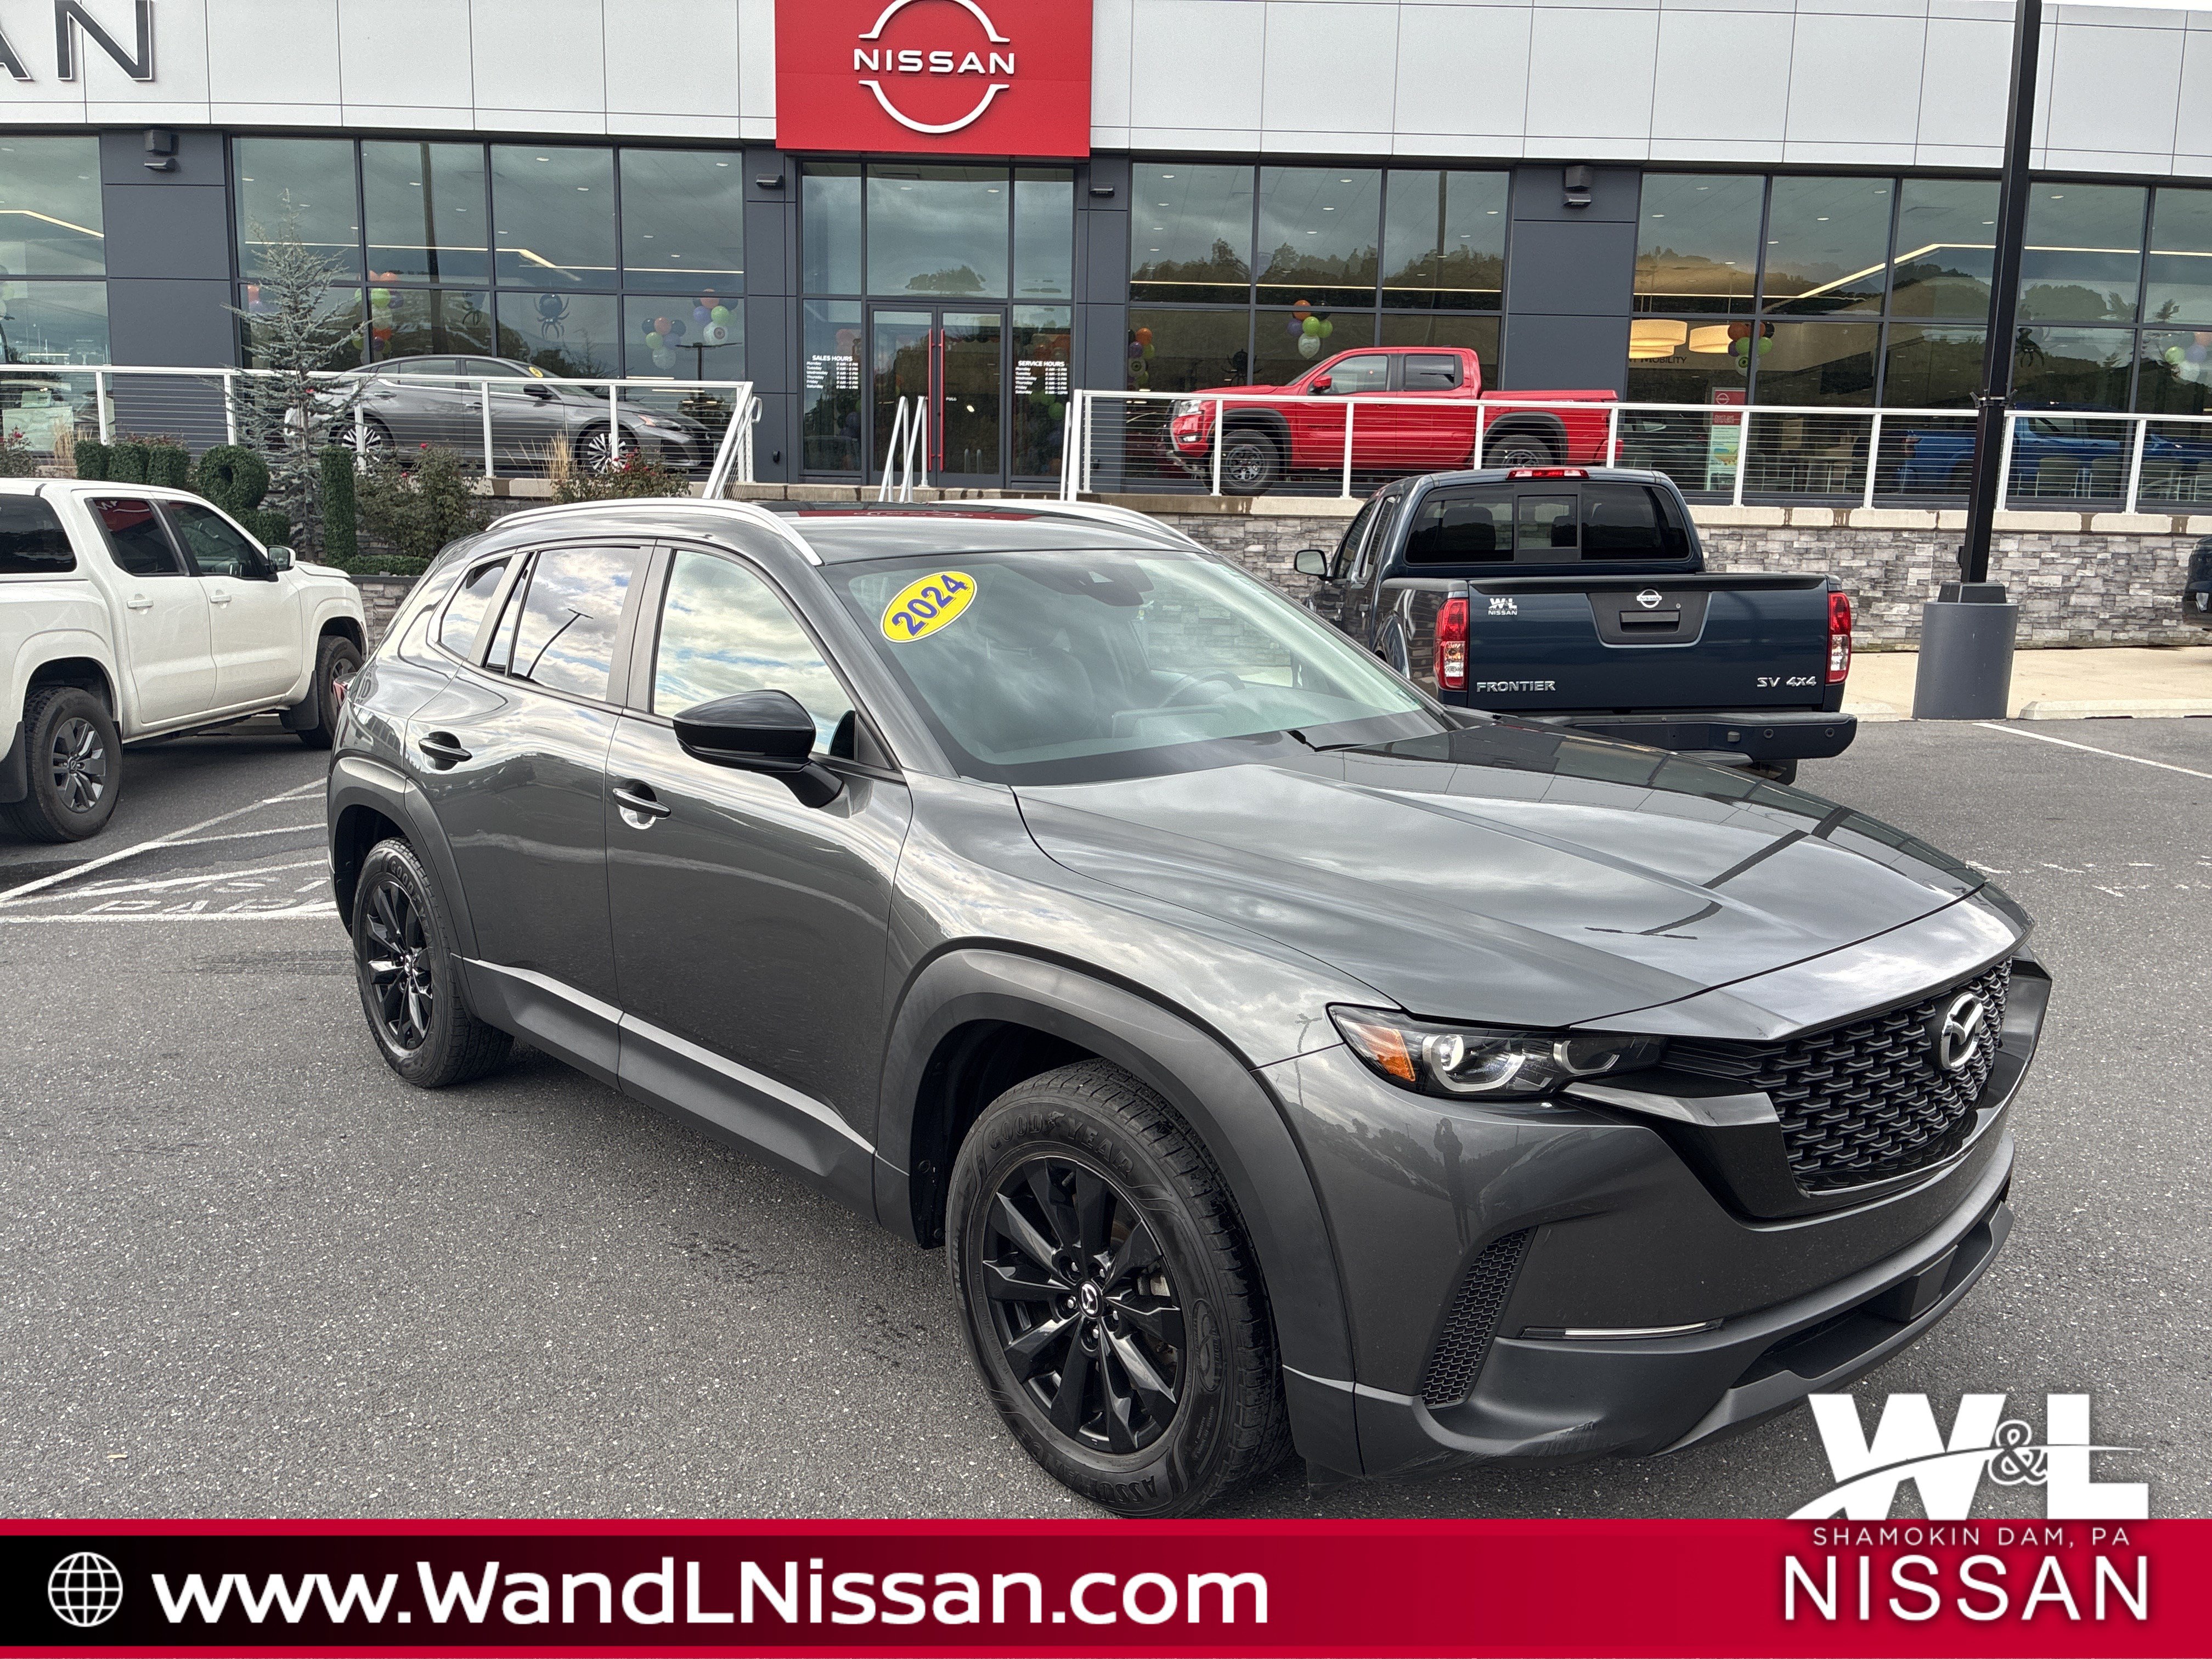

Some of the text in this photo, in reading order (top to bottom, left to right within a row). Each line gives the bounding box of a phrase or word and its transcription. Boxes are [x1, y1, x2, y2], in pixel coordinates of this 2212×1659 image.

[854, 48, 1015, 74] NISSAN
[891, 574, 971, 637] 2024
[1476, 680, 1556, 692] FRONTIER
[1757, 676, 1781, 688] SV
